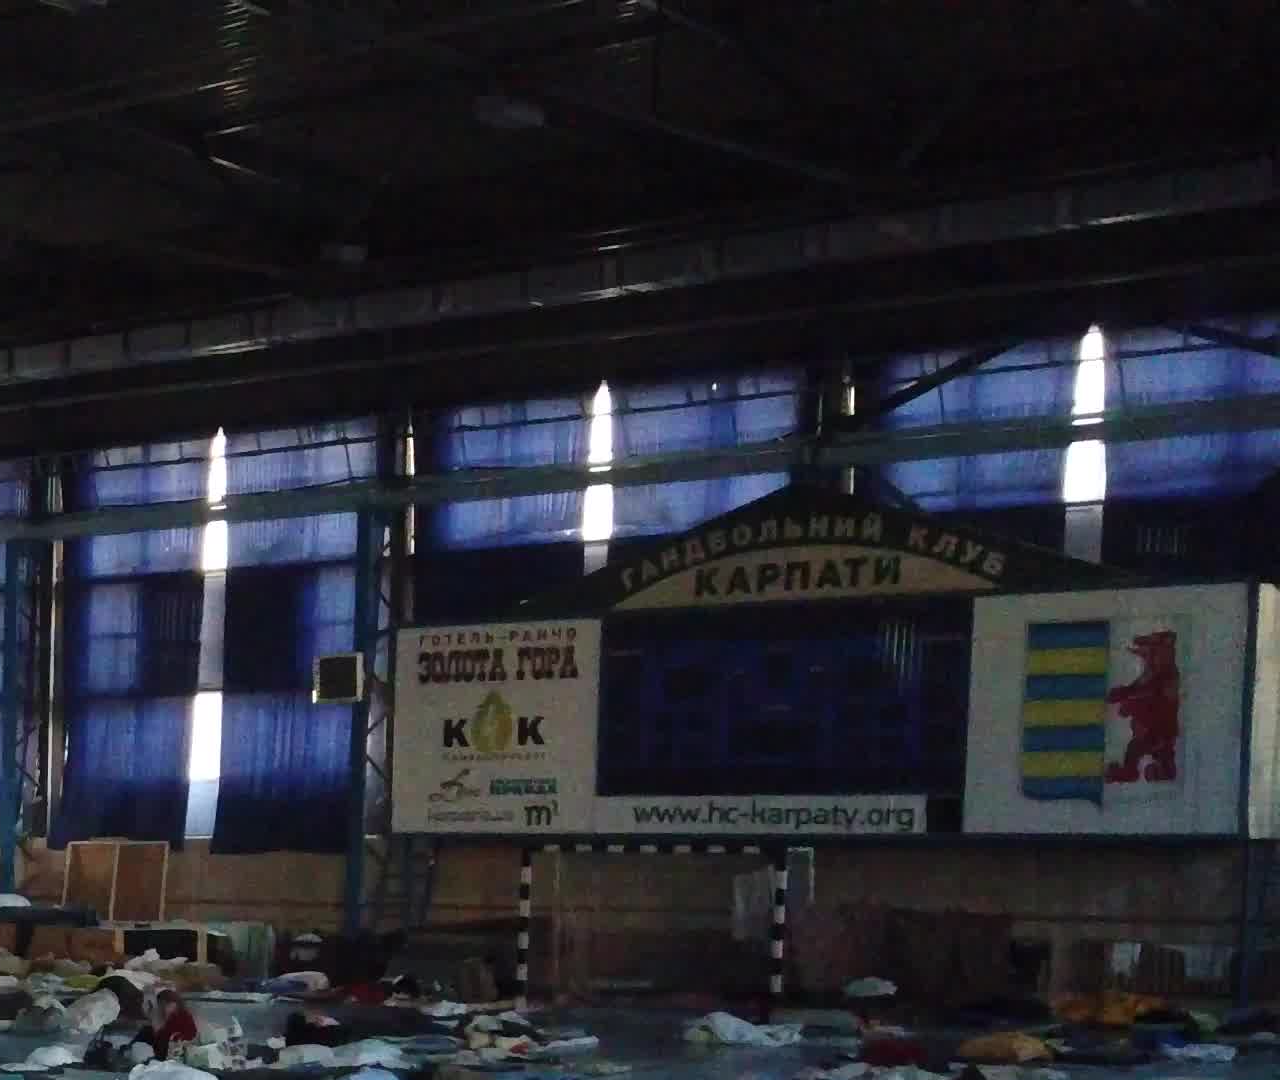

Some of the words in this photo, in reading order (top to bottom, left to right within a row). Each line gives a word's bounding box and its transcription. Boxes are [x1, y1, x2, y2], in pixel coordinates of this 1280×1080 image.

[620, 512, 884, 593] ГАНДБОЛЬНИЙ
[907, 526, 1007, 576] КЛУБ
[693, 556, 903, 599] КАРПАТИ
[417, 648, 507, 684] ЗОЛОТА
[516, 645, 579, 681] ГОРА
[633, 800, 915, 831] www.hc-karpaty.org
